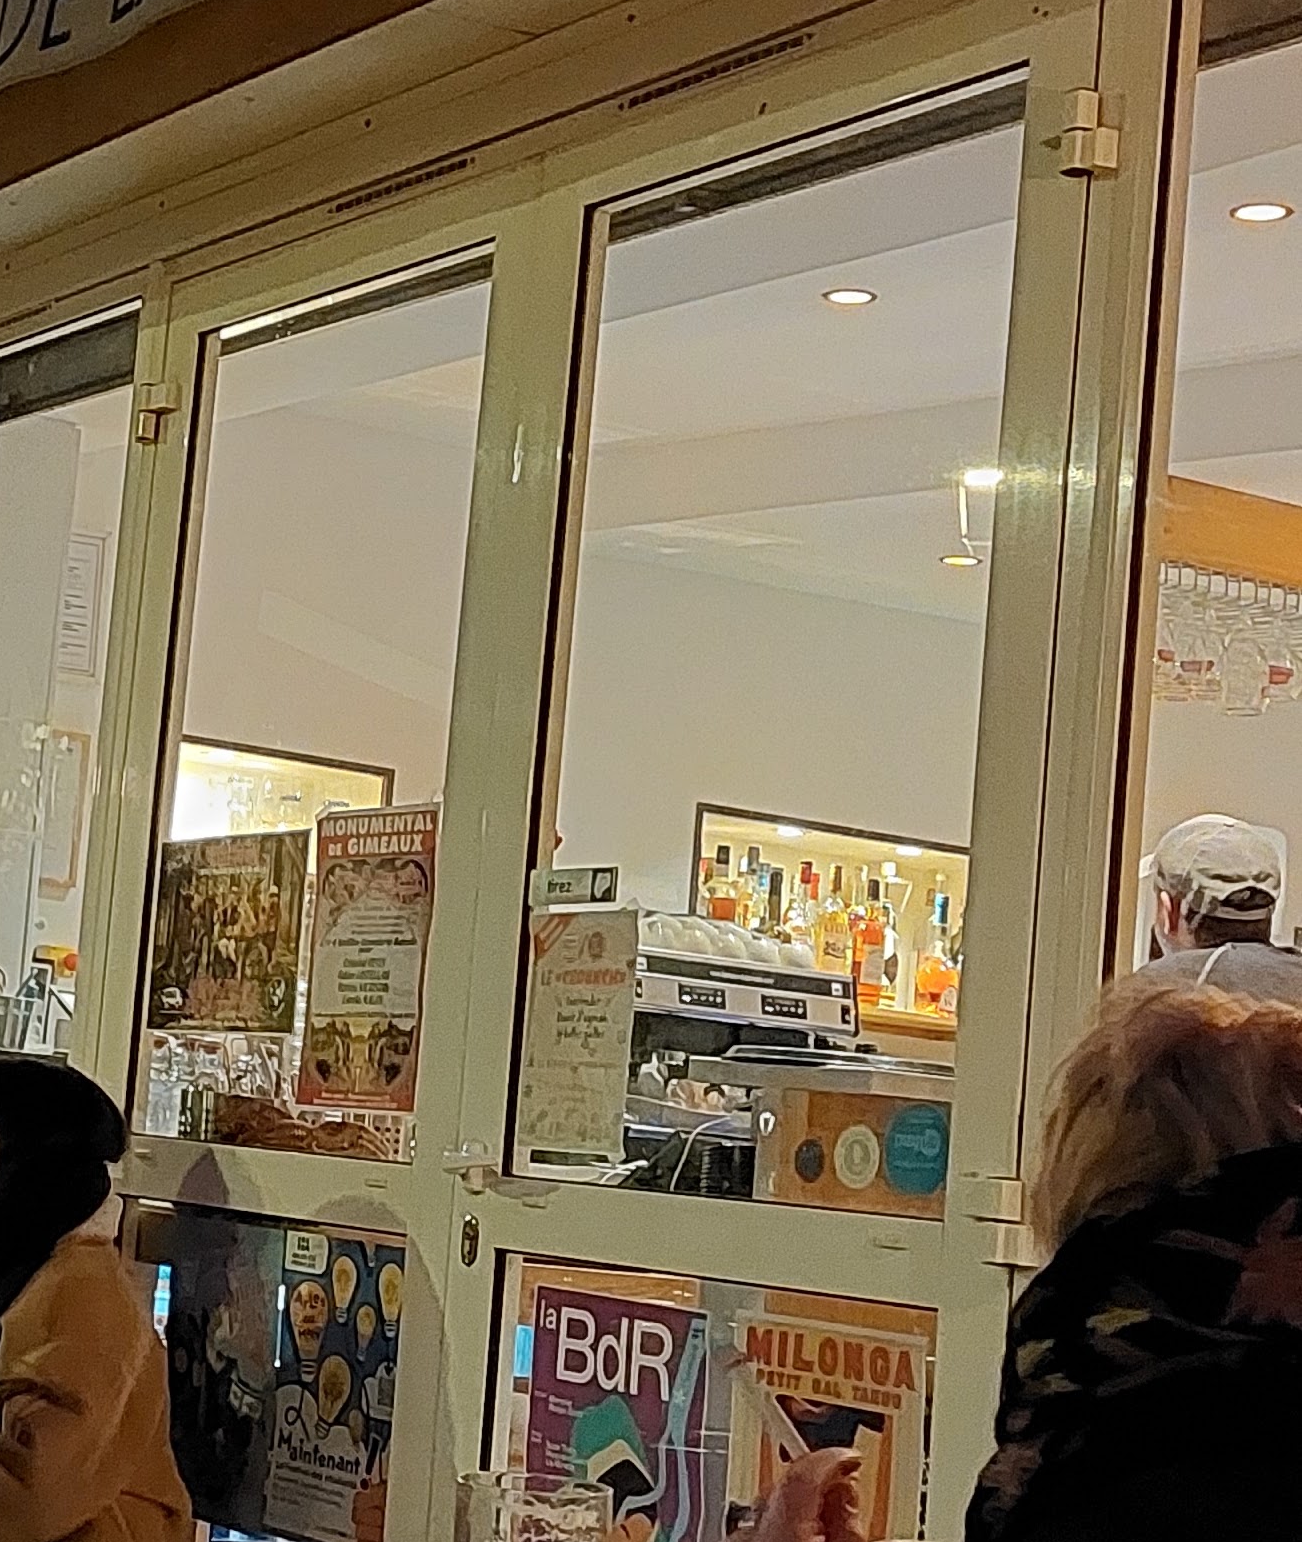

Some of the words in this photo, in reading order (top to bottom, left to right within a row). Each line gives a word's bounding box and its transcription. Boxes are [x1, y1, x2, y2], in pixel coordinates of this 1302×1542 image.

[321, 813, 434, 837] MONUMENTAL
[328, 842, 343, 856] DE
[347, 834, 424, 855] GIMEAUX
[539, 1299, 557, 1331] la
[556, 1306, 674, 1402] BdR
[746, 1325, 918, 1393] MILONGA
[277, 1428, 361, 1476] Maintenant
